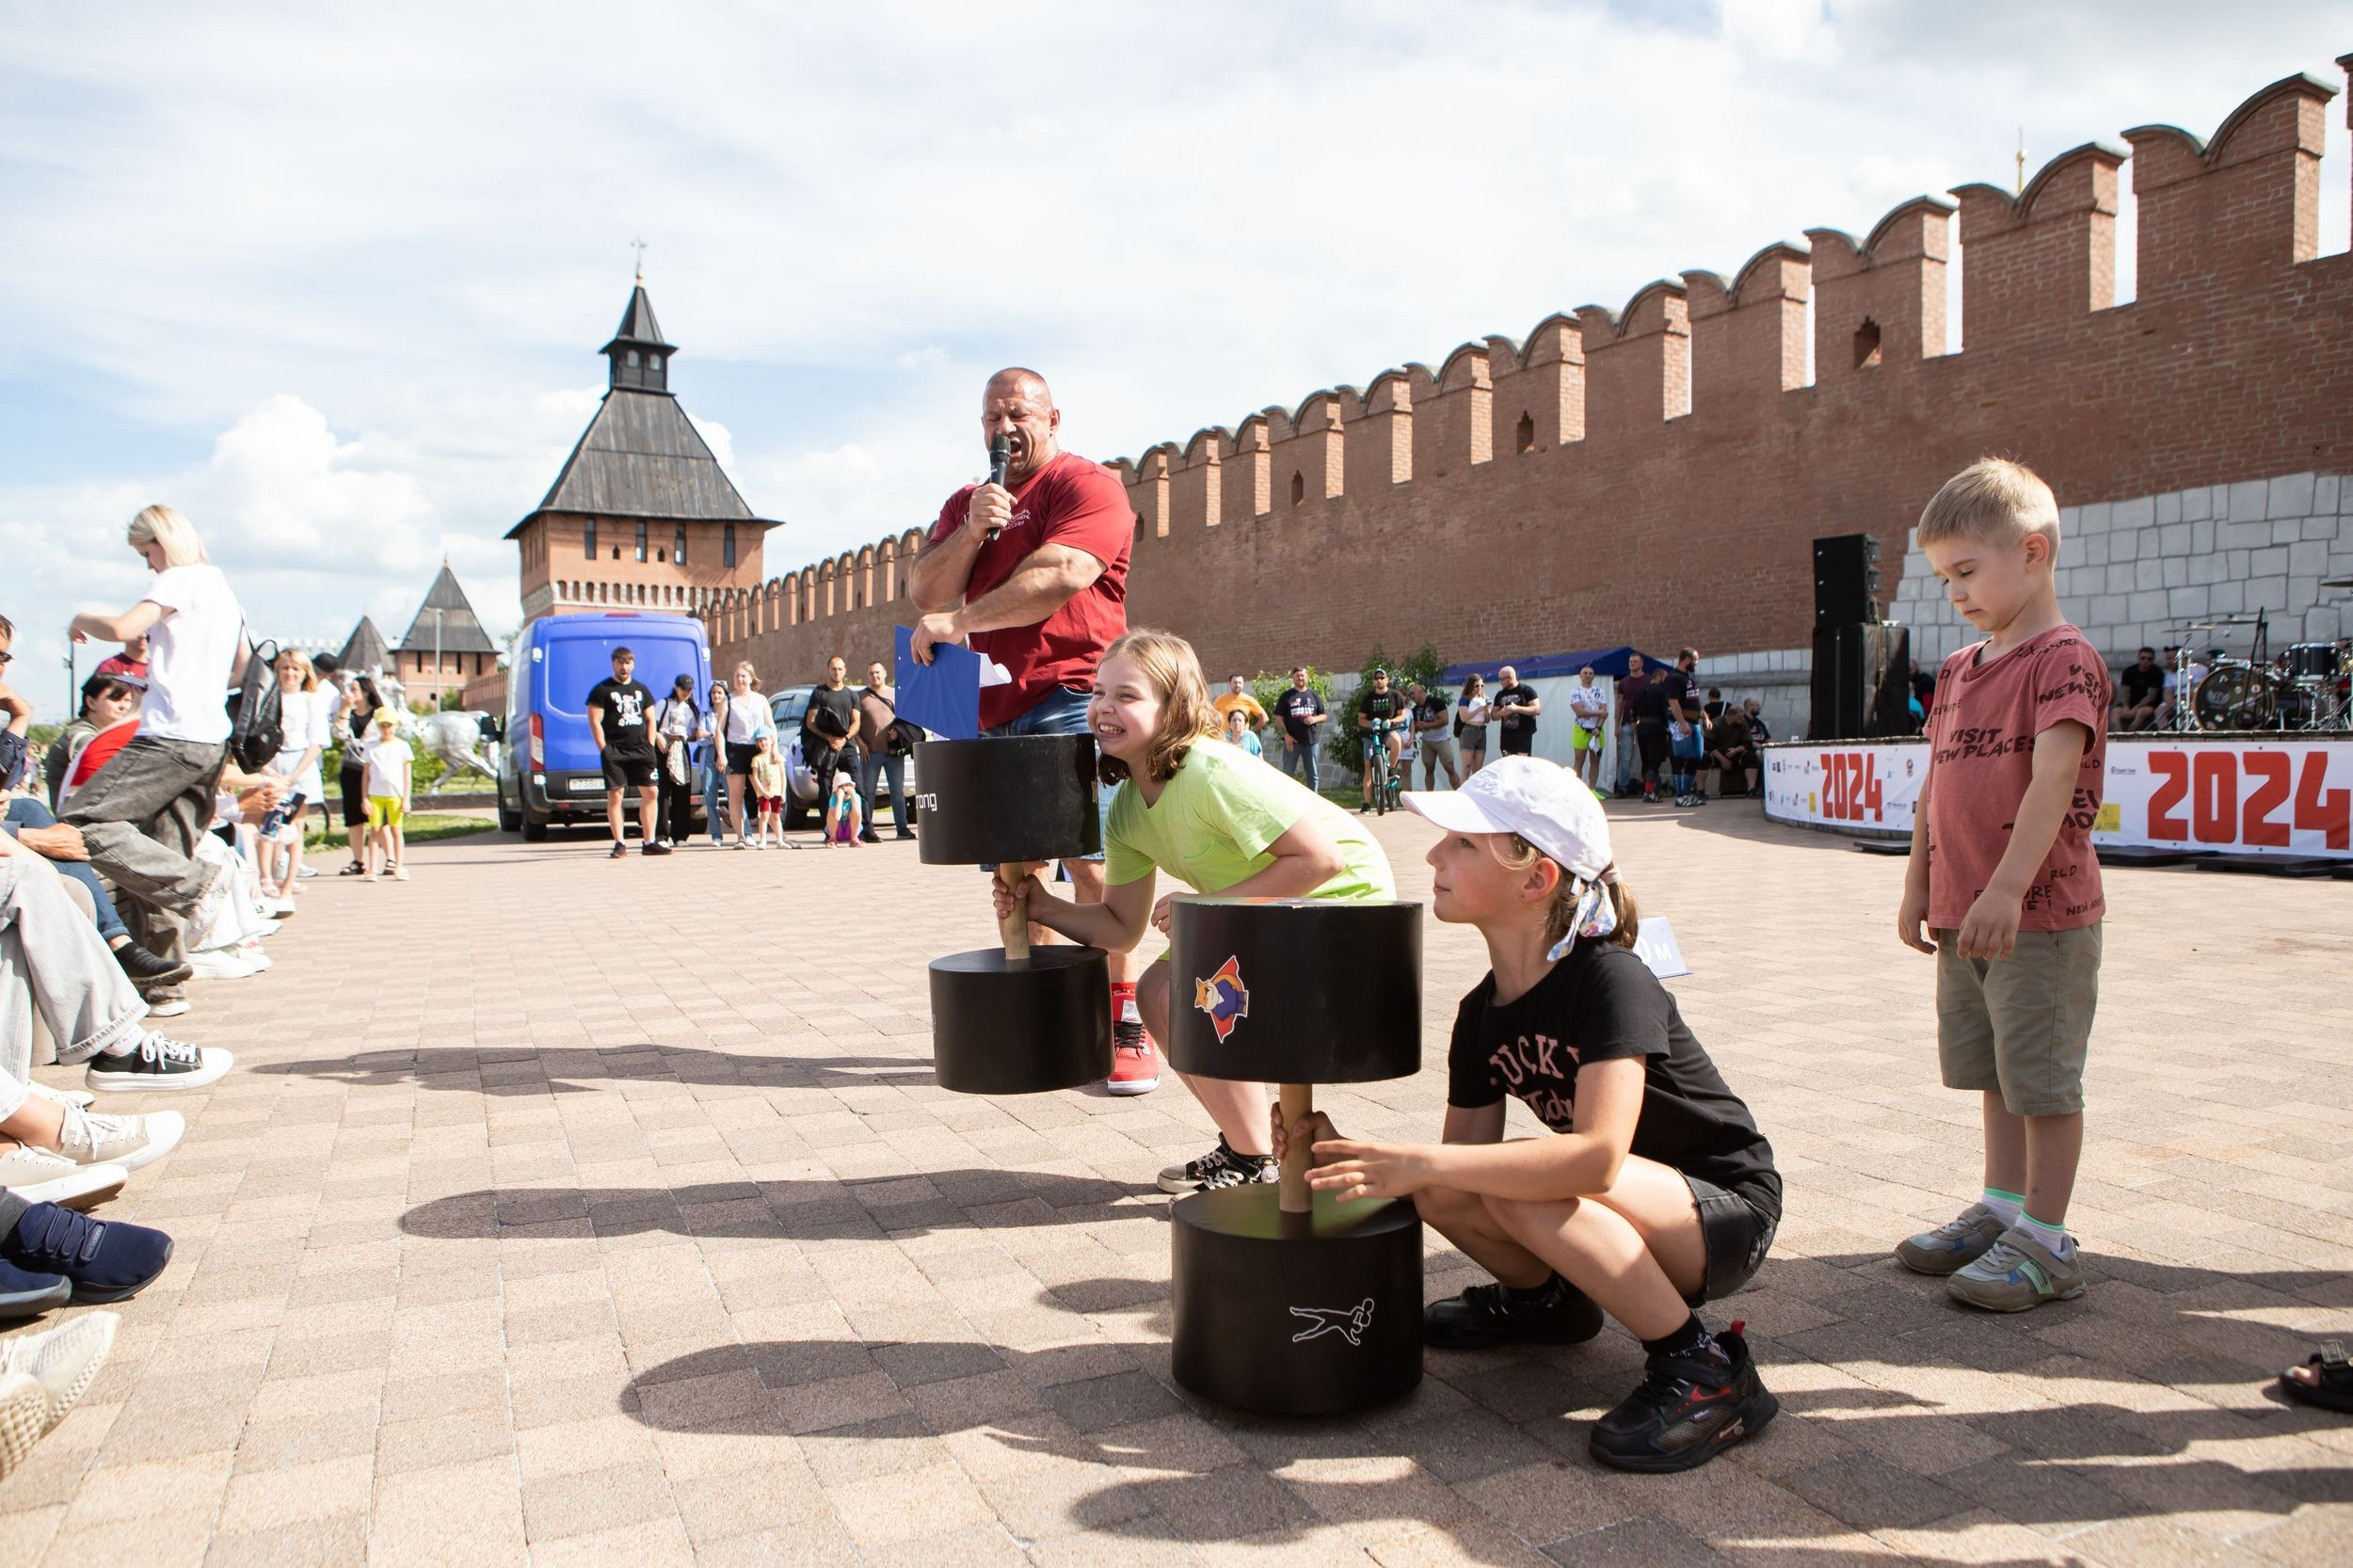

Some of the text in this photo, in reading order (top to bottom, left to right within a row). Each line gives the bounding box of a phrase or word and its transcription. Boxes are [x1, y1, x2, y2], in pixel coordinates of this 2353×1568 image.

[1950, 728, 2003, 744] VISIT
[1820, 753, 1882, 822] 2024
[2148, 751, 2351, 851] 2024
